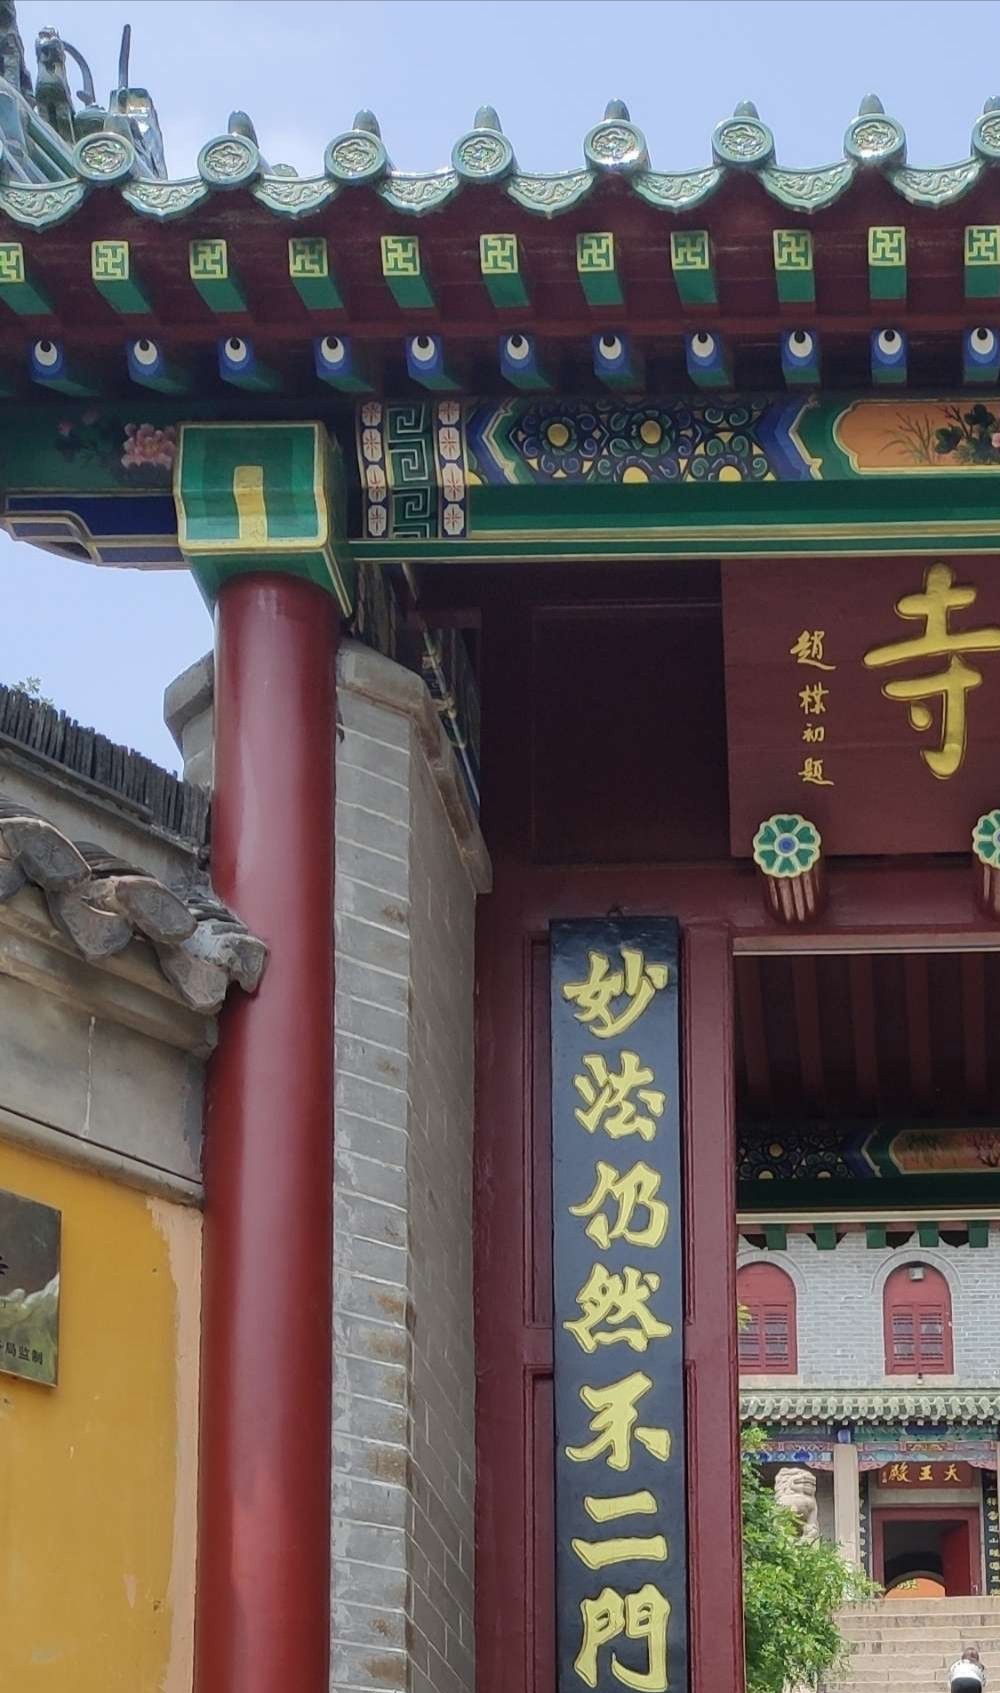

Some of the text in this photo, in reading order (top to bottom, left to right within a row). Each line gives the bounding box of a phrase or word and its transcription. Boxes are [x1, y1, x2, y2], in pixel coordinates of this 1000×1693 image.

[562, 946, 674, 1693] 妙法仍然不二門
[888, 1461, 962, 1483] 天王殿
